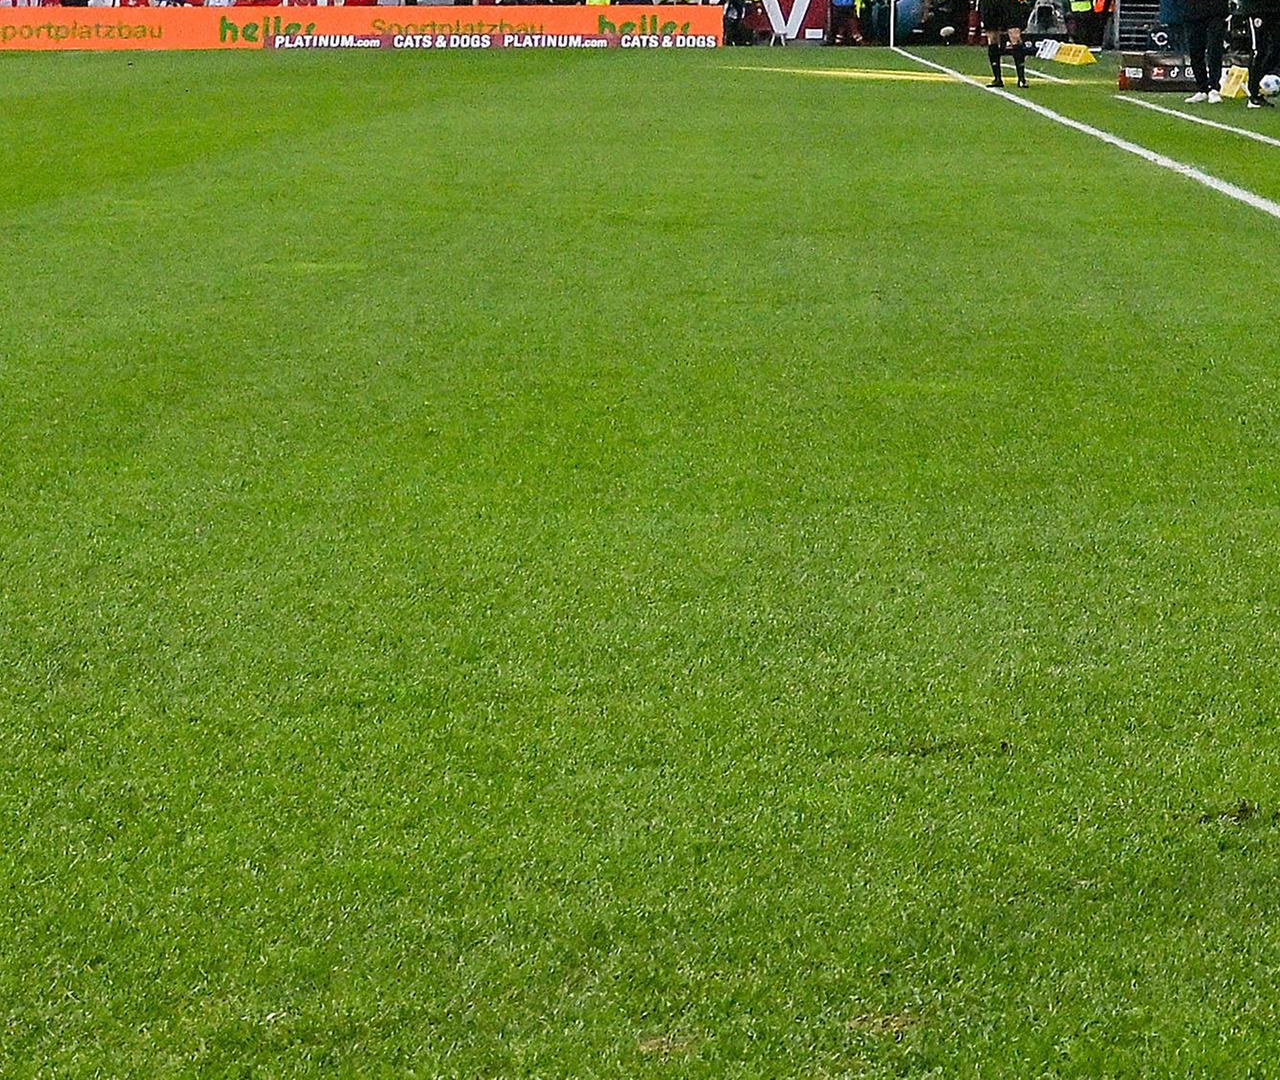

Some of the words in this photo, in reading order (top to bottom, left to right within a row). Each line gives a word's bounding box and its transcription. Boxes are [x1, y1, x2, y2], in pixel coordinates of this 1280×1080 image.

[274, 35, 381, 49] PLATINUM.com
[393, 35, 432, 49] CATS
[435, 35, 447, 49] &
[450, 35, 491, 49] DOGS
[503, 35, 608, 49] PLATINUM.com
[621, 35, 660, 49] CATS
[661, 35, 673, 49] &
[675, 35, 717, 49] DOGS
